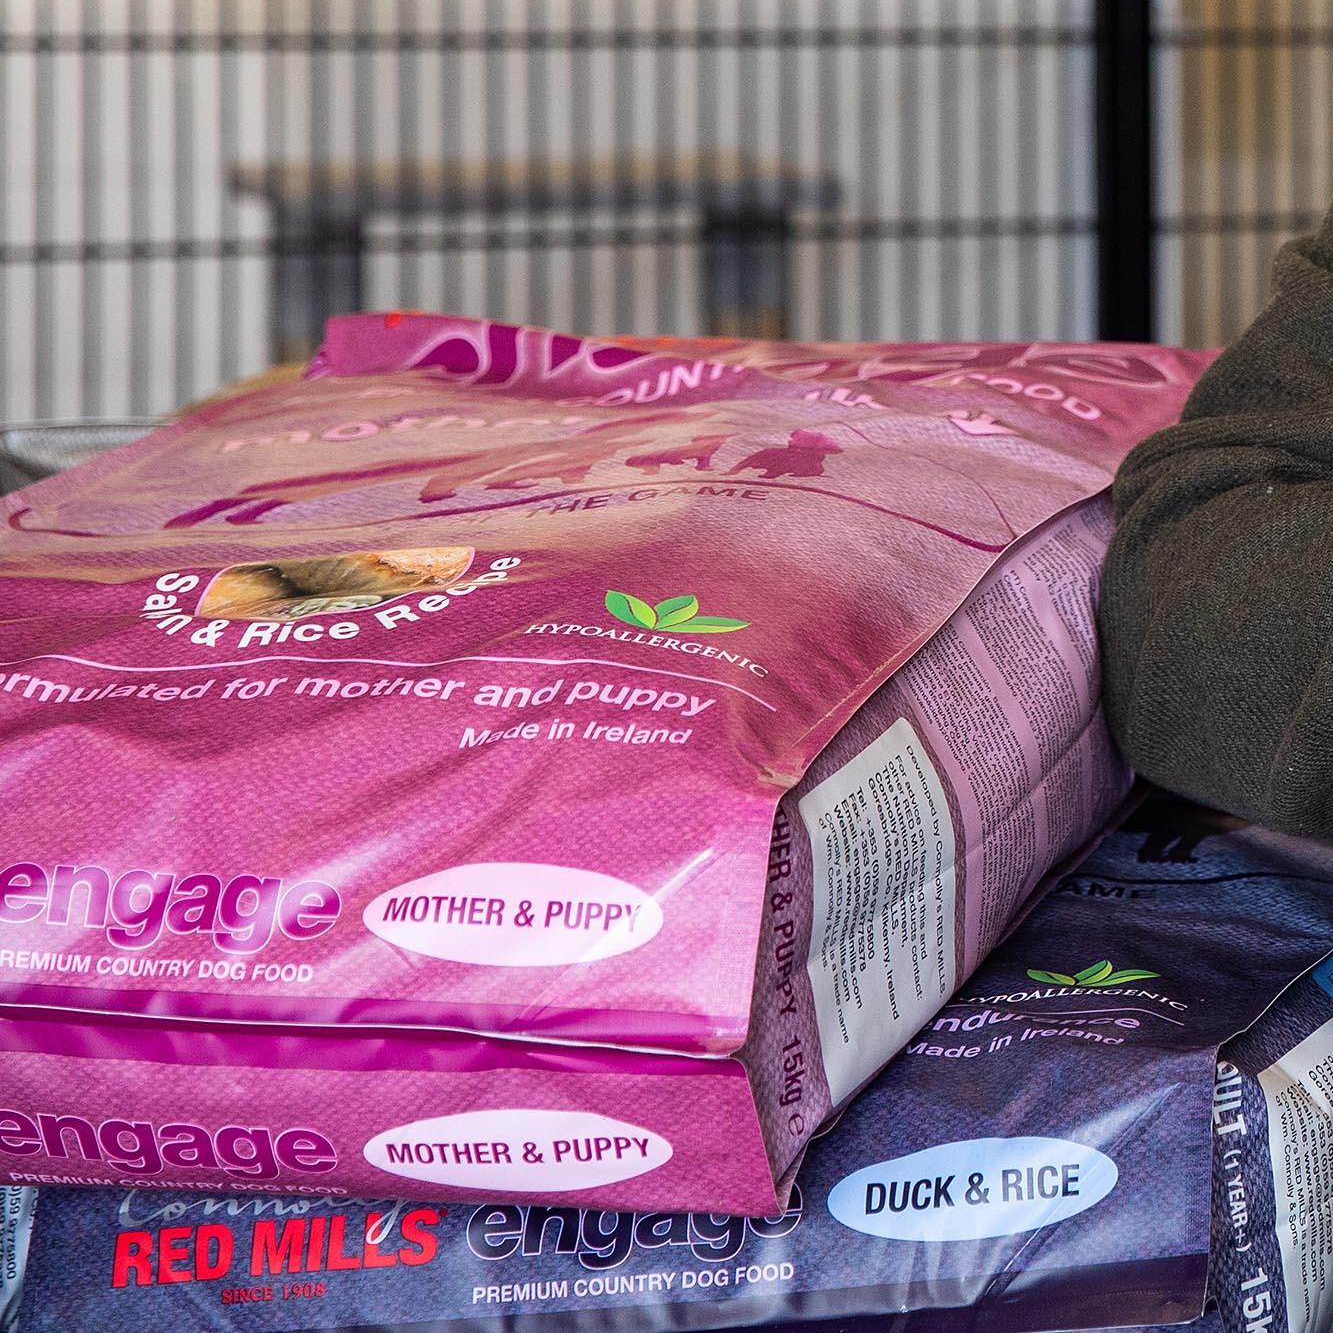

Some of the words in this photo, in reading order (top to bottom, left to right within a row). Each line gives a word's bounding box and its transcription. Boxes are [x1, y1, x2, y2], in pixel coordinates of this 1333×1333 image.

[190, 618, 231, 648] &
[237, 620, 360, 650] Rice
[373, 555, 523, 630] Recipe
[523, 622, 770, 679] HYPOALLERGENIC
[220, 676, 288, 700] for
[294, 675, 466, 702] mother
[472, 678, 565, 709] and
[565, 679, 718, 718] puppy
[458, 721, 541, 750] Made
[548, 717, 575, 741] in
[583, 720, 694, 746] Ireland
[888, 761, 904, 795] other
[895, 755, 907, 777] For
[906, 745, 937, 817] Developed
[841, 799, 858, 842] Email:
[849, 793, 862, 823] Fax:
[856, 787, 868, 812] Tel:
[875, 772, 899, 847] Connolly's
[882, 766, 894, 792] The
[893, 796, 910, 857] Nutrition
[902, 799, 915, 830] RED
[906, 782, 922, 826] advice
[769, 807, 792, 883] THER
[819, 818, 826, 830] of
[824, 812, 841, 877] Connolly's
[833, 805, 851, 867] Website:
[865, 818, 877, 855] +353
[868, 778, 892, 871] Goresbridge,
[919, 829, 926, 847] on
[933, 819, 940, 836] by
[860, 829, 869, 867] +353
[911, 834, 919, 877] MILLS
[826, 867, 834, 920] Connolly
[885, 874, 893, 899] Co.
[918, 850, 928, 902] feeding
[935, 841, 943, 913] Connolly's
[1052, 882, 1153, 899] AME
[0, 862, 342, 956] engage
[382, 895, 506, 927] MOTHER
[513, 899, 536, 928] &
[544, 900, 645, 933] PUPPY
[771, 892, 793, 915] &
[909, 881, 918, 942] products
[825, 925, 832, 934] &
[830, 909, 841, 946] MILLS
[839, 873, 851, 1002] www.redmills.com
[849, 849, 863, 1009] engage@redmills.com
[858, 911, 866, 972] 9775378
[868, 899, 877, 959] 9775800
[881, 904, 891, 967] Kilkenny,
[936, 917, 944, 947] RED
[0, 949, 92, 974] REMIUM
[96, 954, 196, 978] COUNTRY
[198, 959, 247, 982] DOG
[251, 963, 314, 984] FOOD
[773, 921, 798, 1015] PUPPY
[821, 937, 829, 971] Sons.
[829, 950, 836, 961] is
[912, 945, 923, 1001] contact:
[833, 974, 842, 1006] trade
[887, 970, 900, 1020] Ireland
[838, 1009, 849, 1043] name
[906, 1043, 981, 1059] Made
[987, 1035, 1012, 1053] in
[1018, 1026, 1124, 1046] Ireland
[780, 1035, 806, 1107] 15kg
[1213, 1061, 1246, 1136] DULT
[1275, 1095, 1282, 1107] of
[0, 1108, 338, 1181] engage
[385, 1142, 513, 1165] MOTHER
[522, 1141, 545, 1164] &
[552, 1136, 650, 1163] PUPPY
[1280, 1113, 1288, 1141] Wm.
[1223, 1149, 1242, 1169] (1
[1285, 1145, 1295, 1198] Connolly
[8, 1171, 114, 1187] PREMIUM
[118, 1178, 224, 1191] COUNTRY
[231, 1183, 282, 1192] DOG
[285, 1185, 348, 1195] FOOD
[865, 1174, 956, 1215] DUCK
[965, 1172, 990, 1206] &
[1001, 1163, 1080, 1203] RICE
[1227, 1174, 1252, 1252] YEAR+)
[1289, 1202, 1296, 1211] &
[1297, 1188, 1307, 1226] MILLS
[1304, 1151, 1318, 1283] www.redmills.com
[111, 1223, 235, 1288] RED
[250, 1208, 439, 1277] MILLS
[1289, 1216, 1298, 1249] Sons.
[1301, 1230, 1307, 1239] is
[1302, 1243, 1306, 1251] a
[221, 1287, 273, 1305] SINCE
[281, 1282, 326, 1301] 1908
[472, 1279, 569, 1305] PREMIUM
[573, 1272, 677, 1297] COUNTRY
[681, 1267, 730, 1290] DOG
[734, 1262, 796, 1285] FOOD
[1303, 1288, 1311, 1323] name
